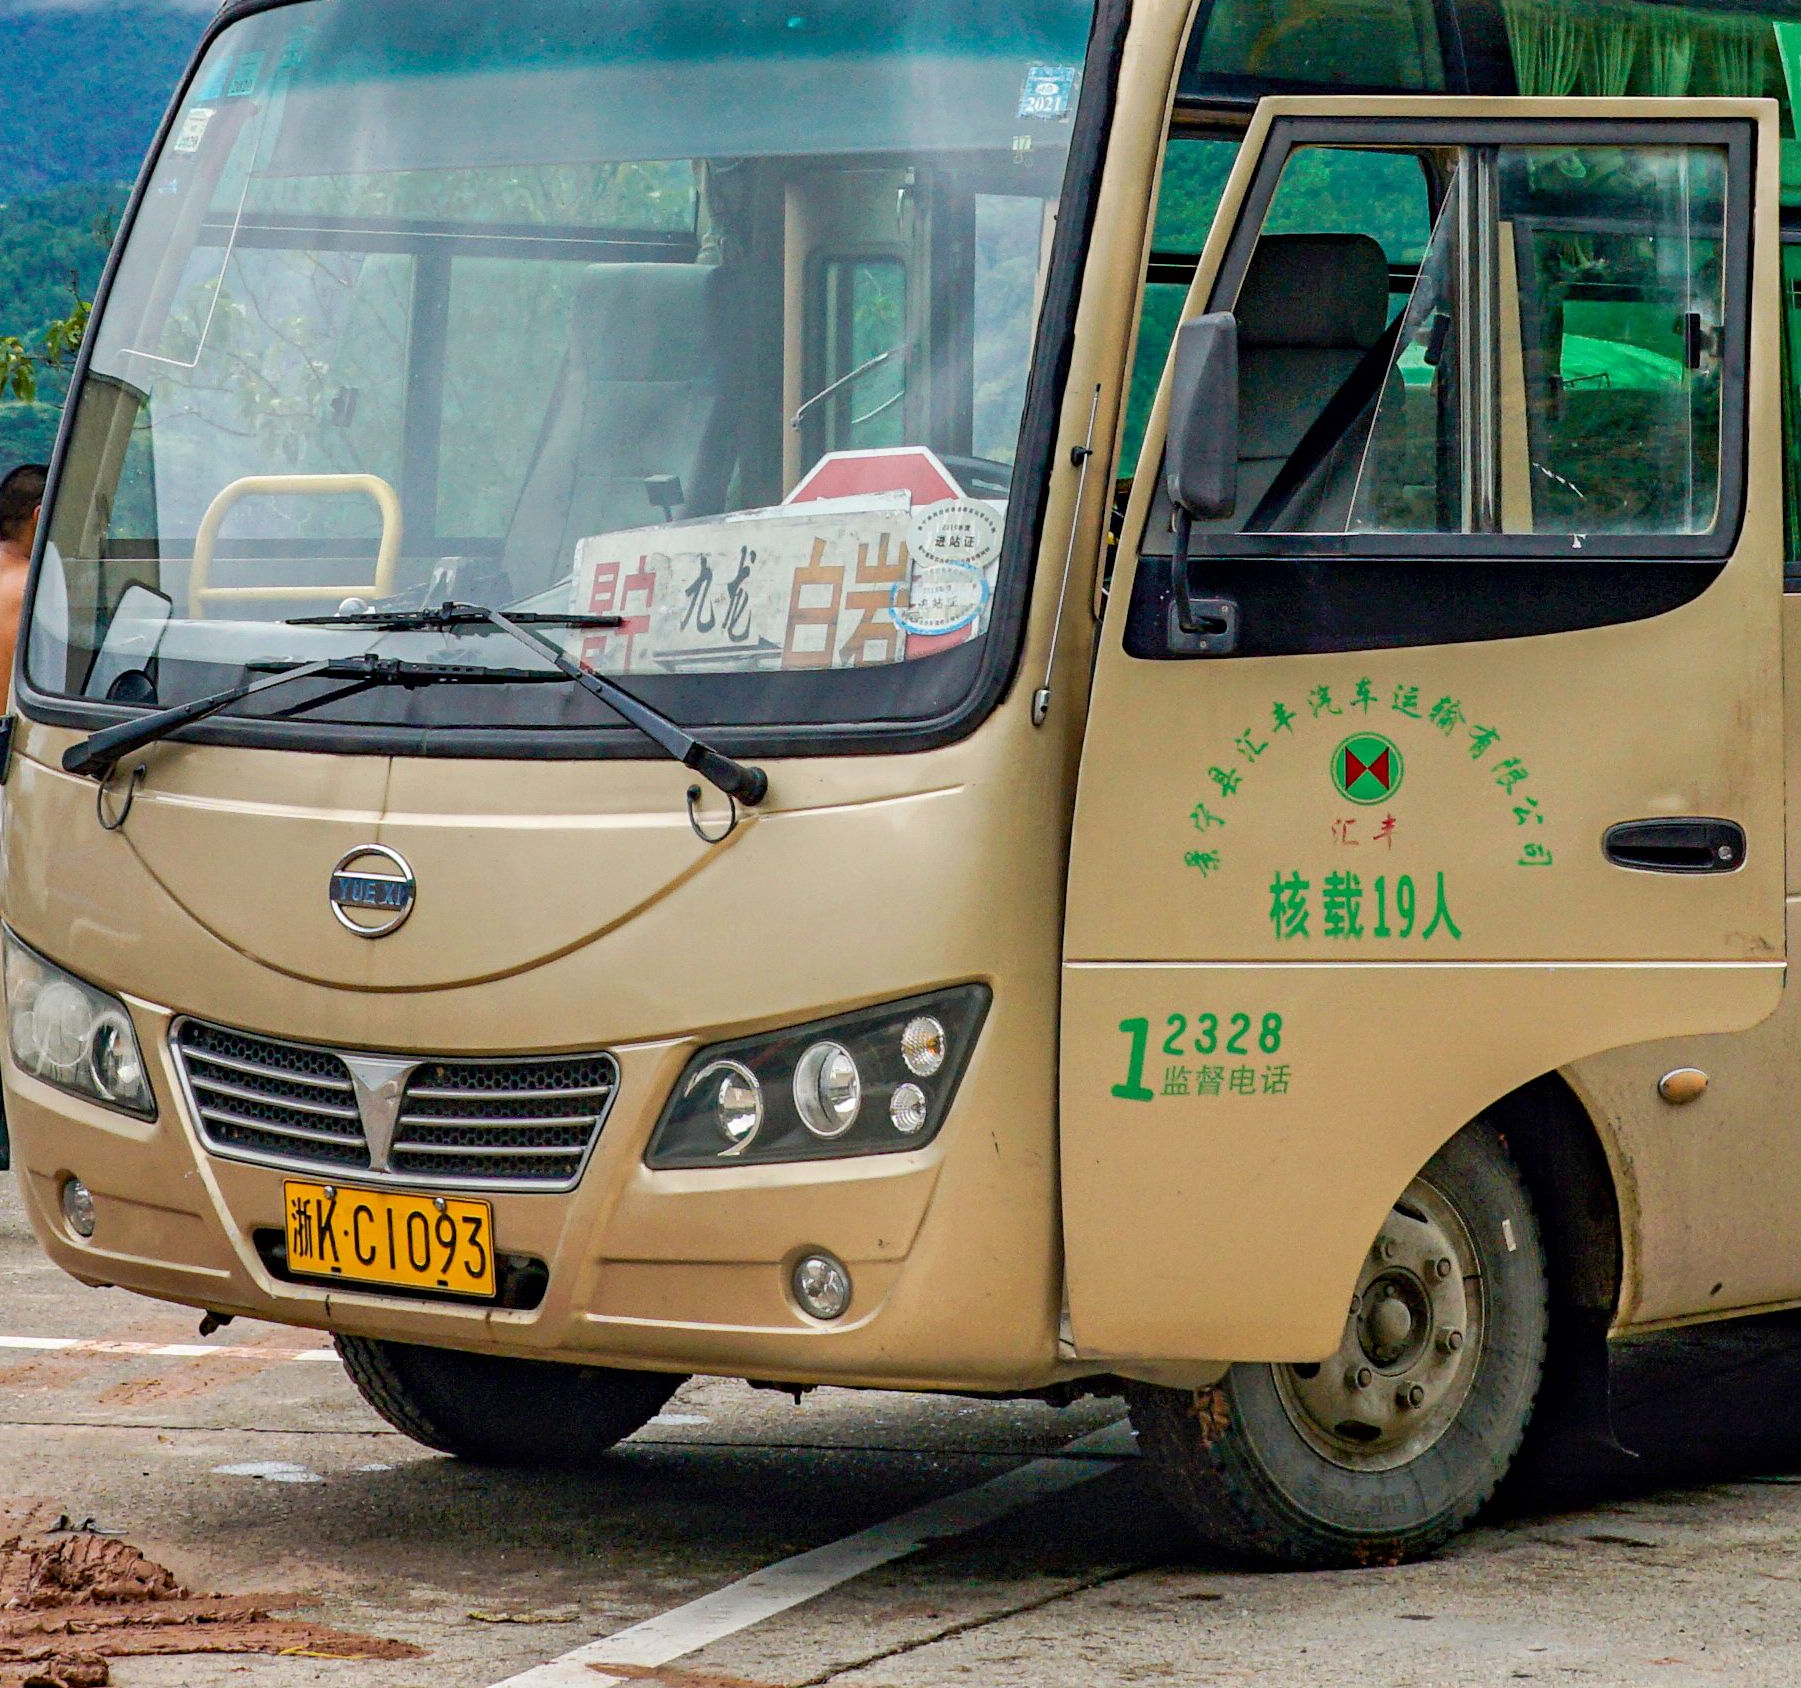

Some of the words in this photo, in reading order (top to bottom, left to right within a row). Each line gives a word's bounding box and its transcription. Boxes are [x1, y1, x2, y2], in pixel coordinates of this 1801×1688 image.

[1025, 96, 1062, 112] 2021
[935, 535, 975, 547] 进站证
[1331, 812, 1397, 850] 汇丰
[1269, 871, 1463, 942] 核载19人
[1160, 1064, 1291, 1097] 监督电话
